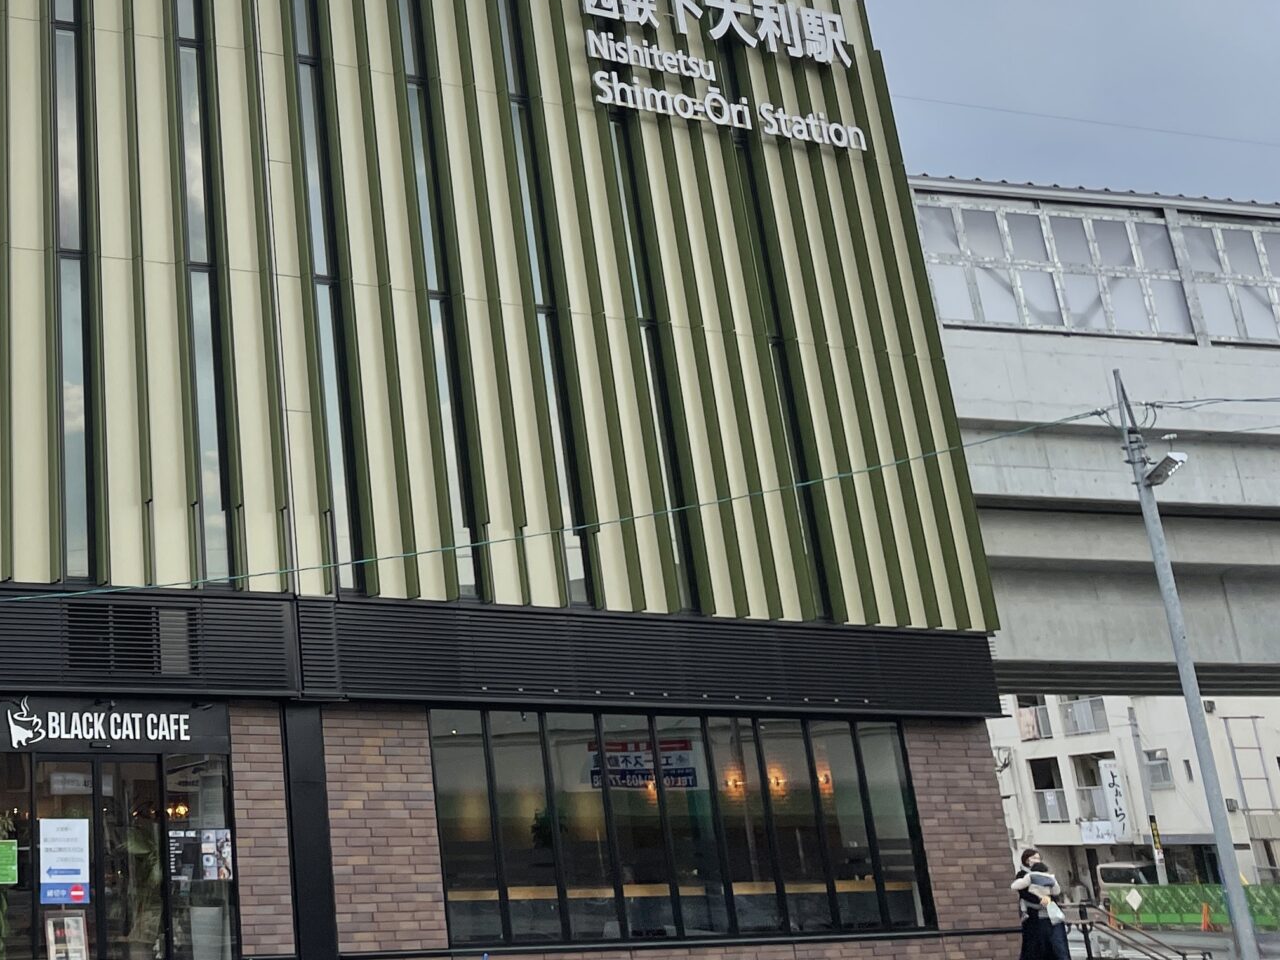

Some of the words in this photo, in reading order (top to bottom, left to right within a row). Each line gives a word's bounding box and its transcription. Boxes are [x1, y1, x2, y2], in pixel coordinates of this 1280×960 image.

[586, 29, 717, 82] Nishitetsu
[592, 70, 753, 130] Shimo-Ōri
[759, 102, 868, 152] Station
[47, 711, 107, 740] BLACK
[110, 712, 142, 741] CAT
[146, 713, 191, 741] CAFE
